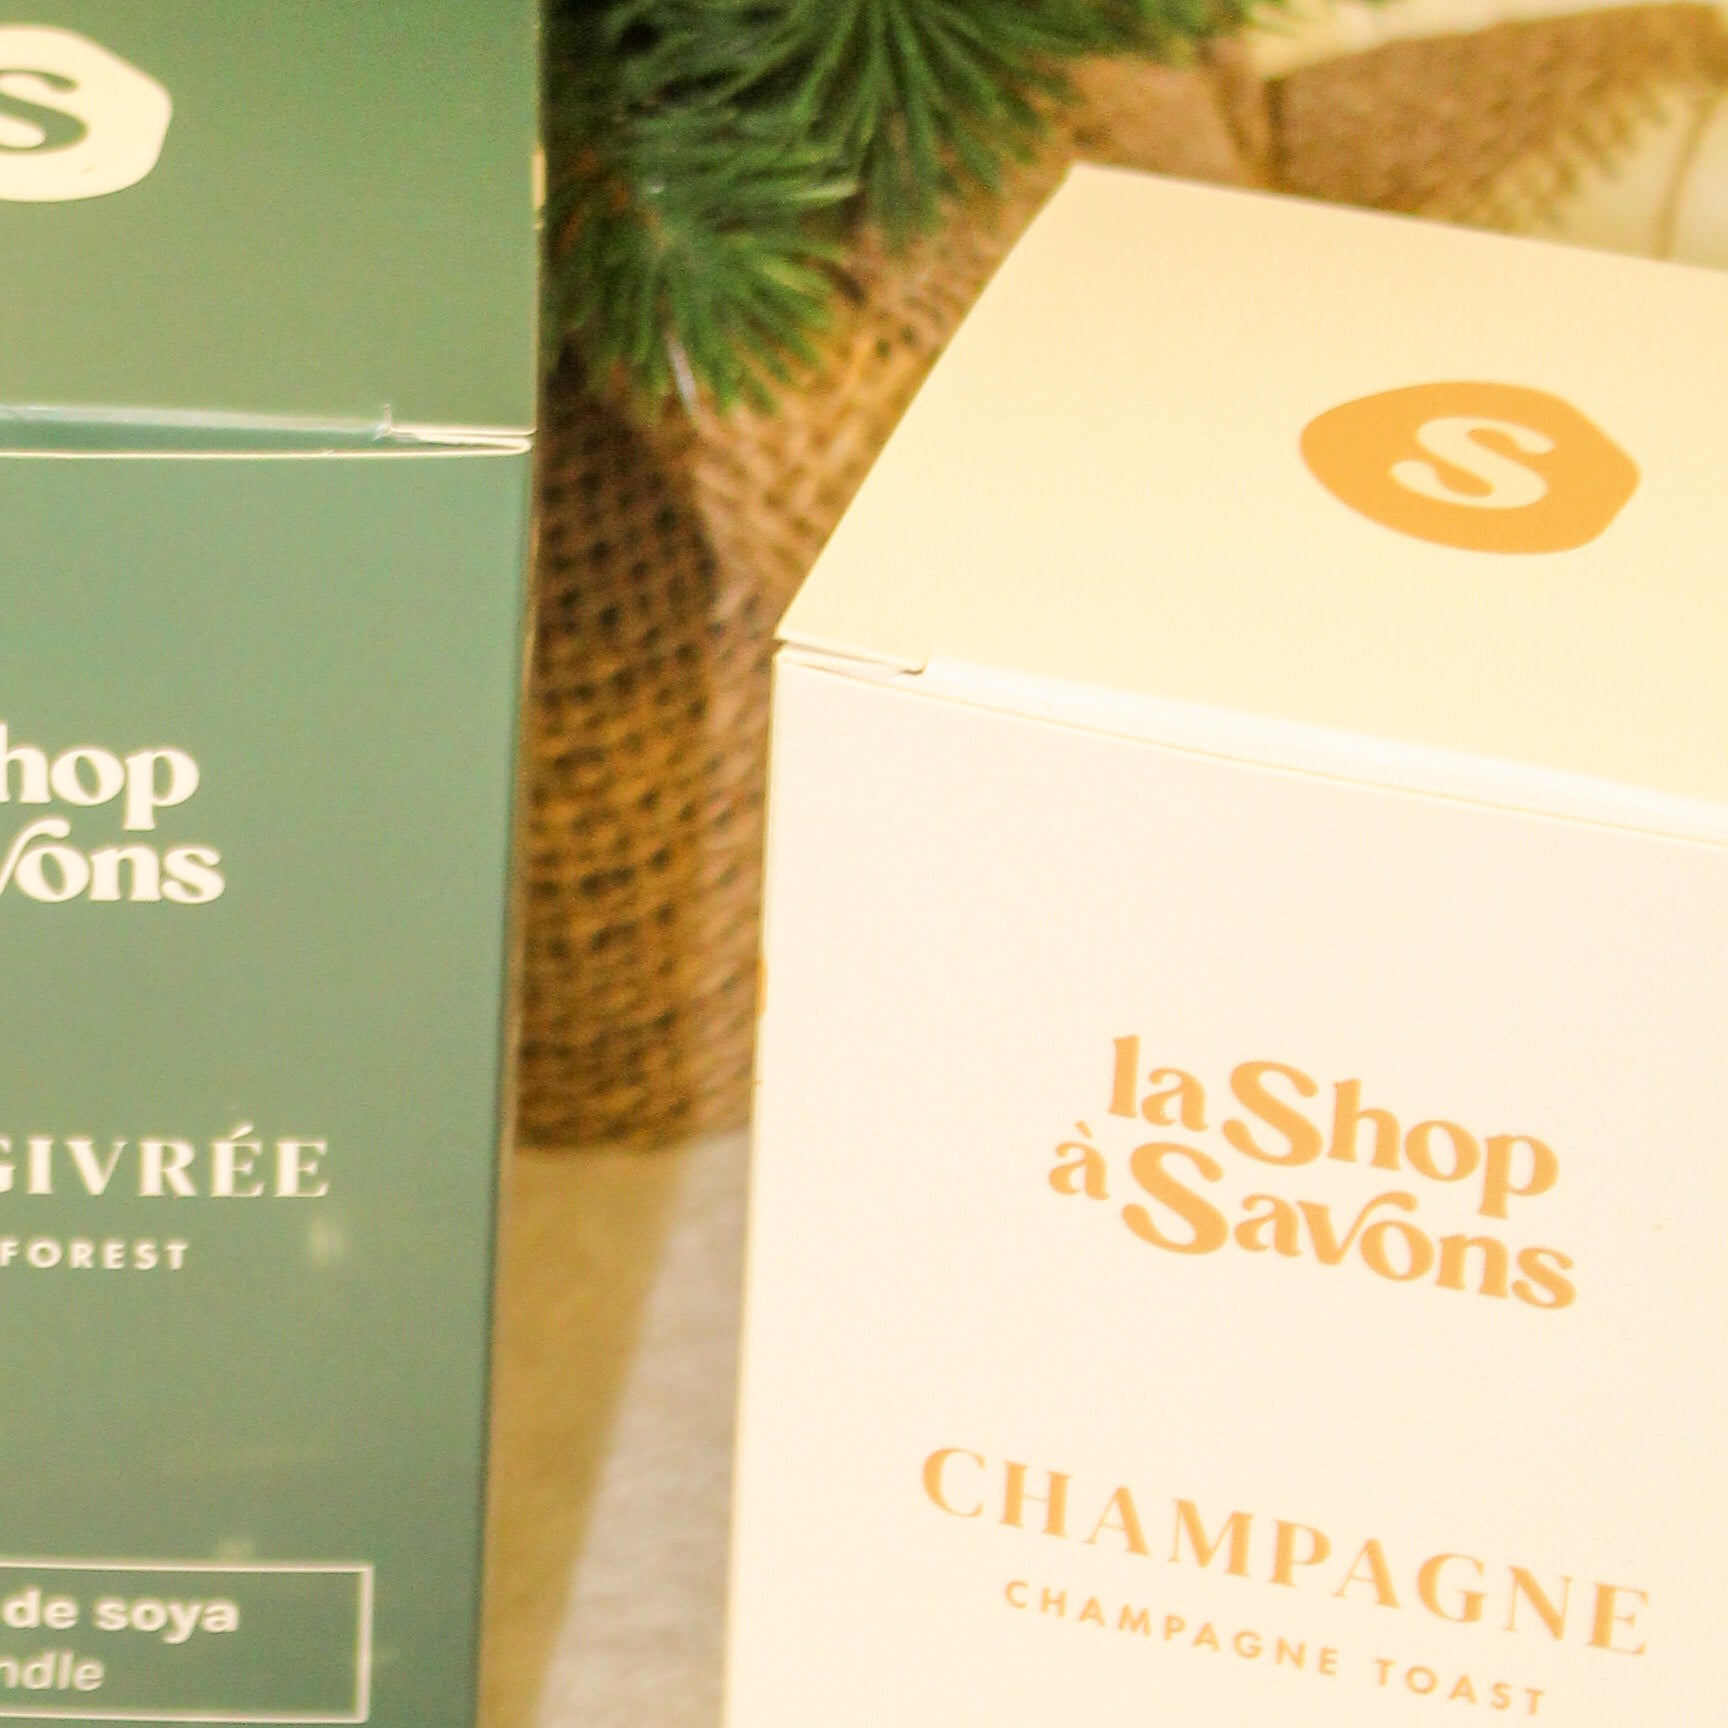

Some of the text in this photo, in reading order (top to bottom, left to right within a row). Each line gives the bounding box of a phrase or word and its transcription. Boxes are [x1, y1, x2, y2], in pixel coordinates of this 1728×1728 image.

[1389, 414, 1556, 510] S
[1108, 1034, 1559, 1220] la Shop
[1047, 1119, 1577, 1311] à Savons
[2, 1588, 78, 1630] de
[95, 1596, 242, 1644] soya
[921, 1446, 1649, 1657] CHAMPAGNE
[1003, 1580, 1546, 1717] CHAMPAGNE TOAST
